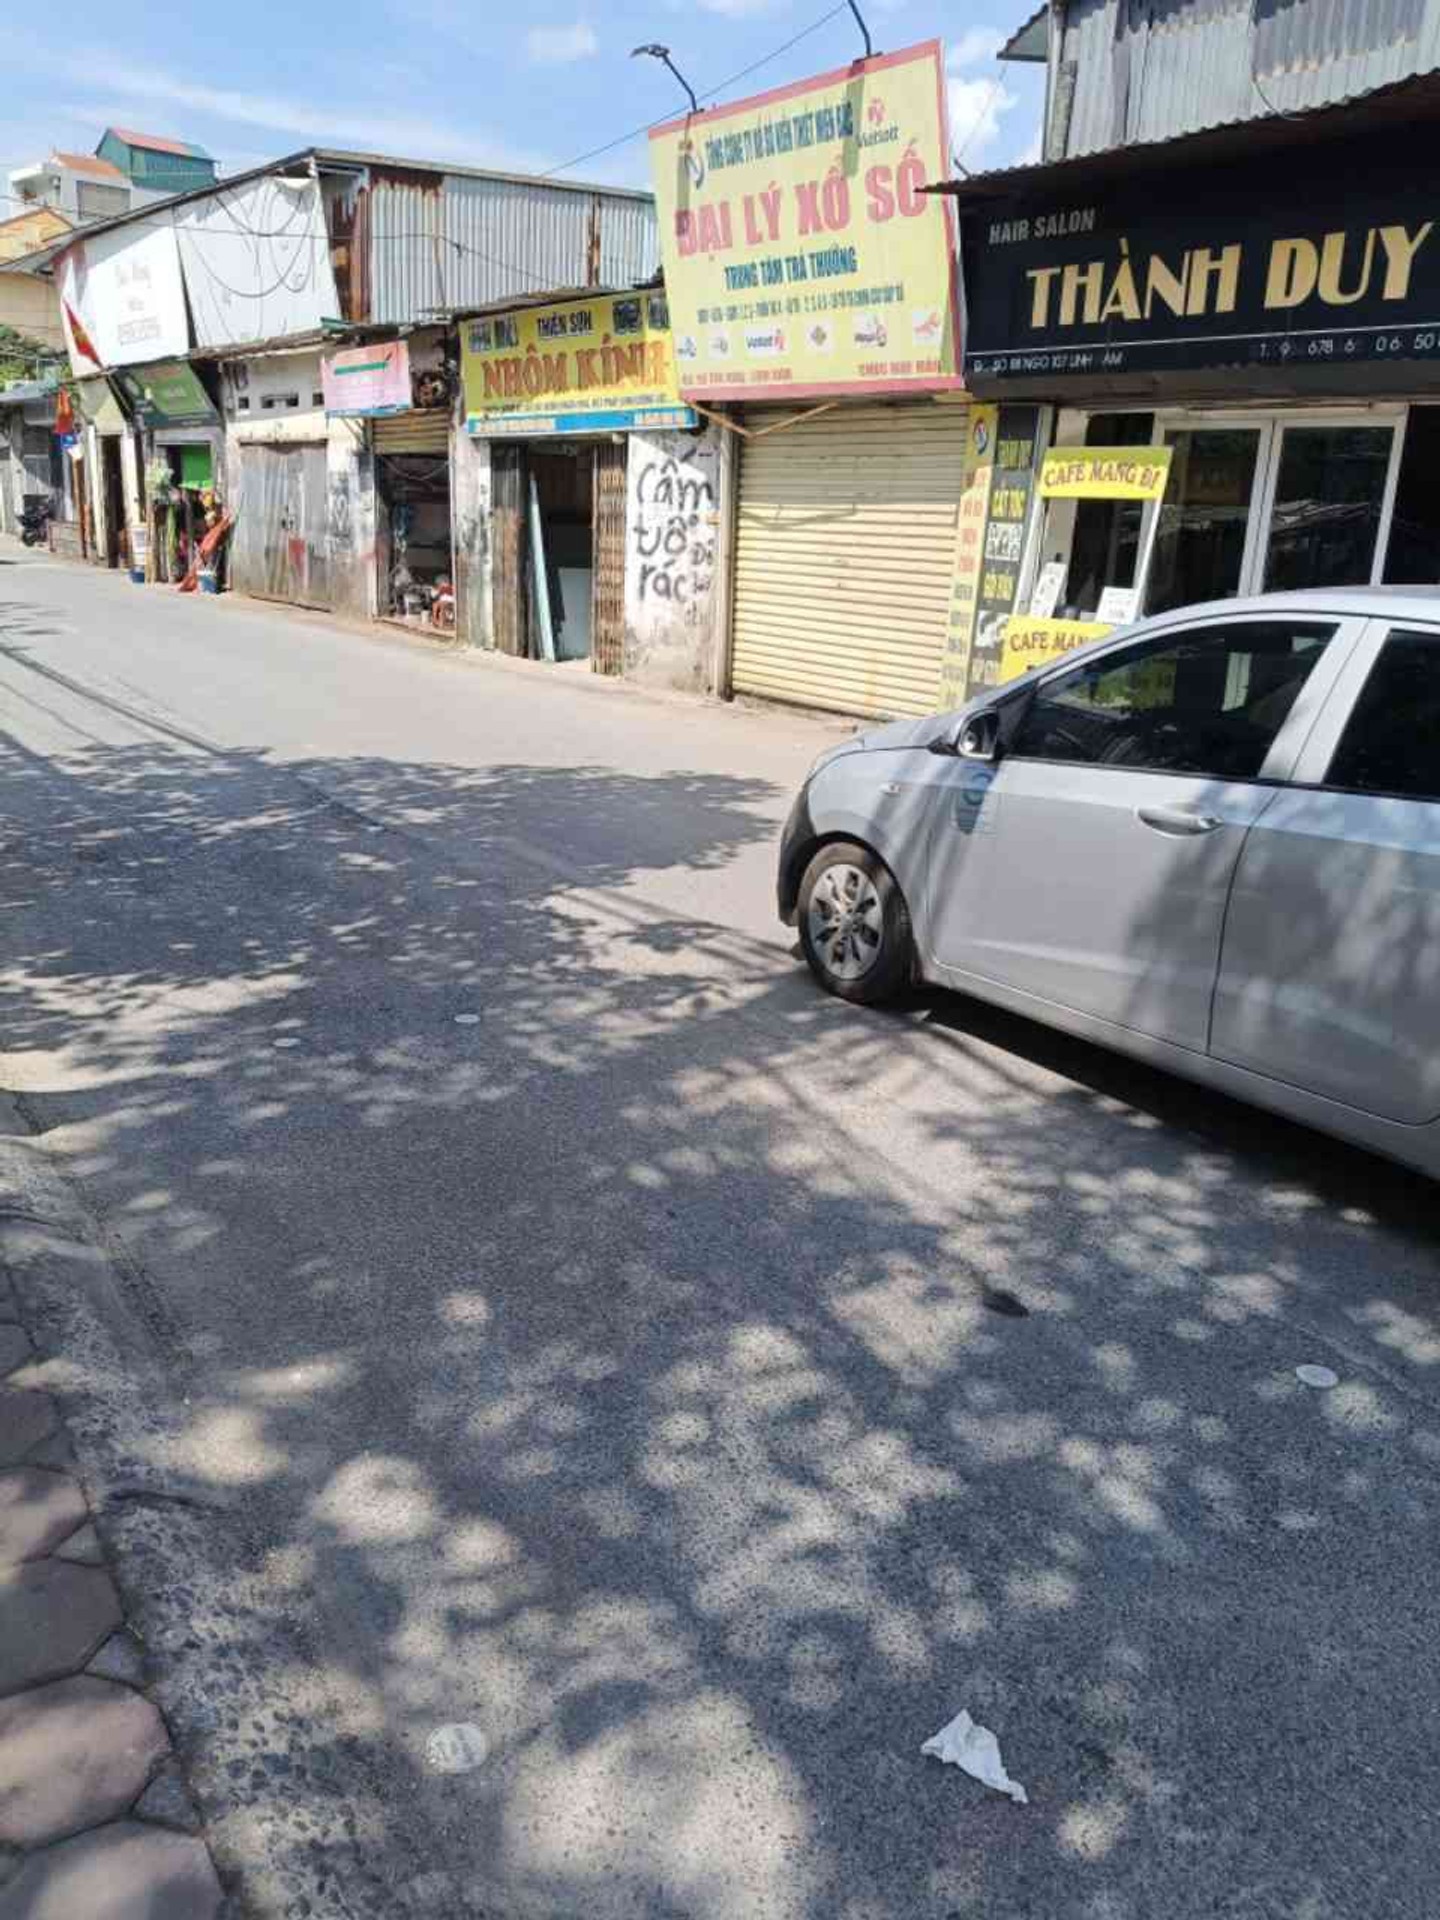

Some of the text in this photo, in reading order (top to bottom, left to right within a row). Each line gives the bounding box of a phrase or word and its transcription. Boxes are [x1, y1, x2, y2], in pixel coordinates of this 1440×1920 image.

[674, 138, 928, 261] ĐẠI LÝ XỔ SỐ
[989, 207, 1095, 245] HAIR SALON
[1025, 221, 1434, 329] THÀNH DUY
[1413, 332, 1440, 350] 50
[481, 333, 667, 398] NHÔM KÍNH
[1044, 463, 1085, 488] CAFE
[1089, 459, 1136, 484] MANG
[640, 558, 687, 602] rác
[1009, 630, 1088, 651] CAFE MAN
